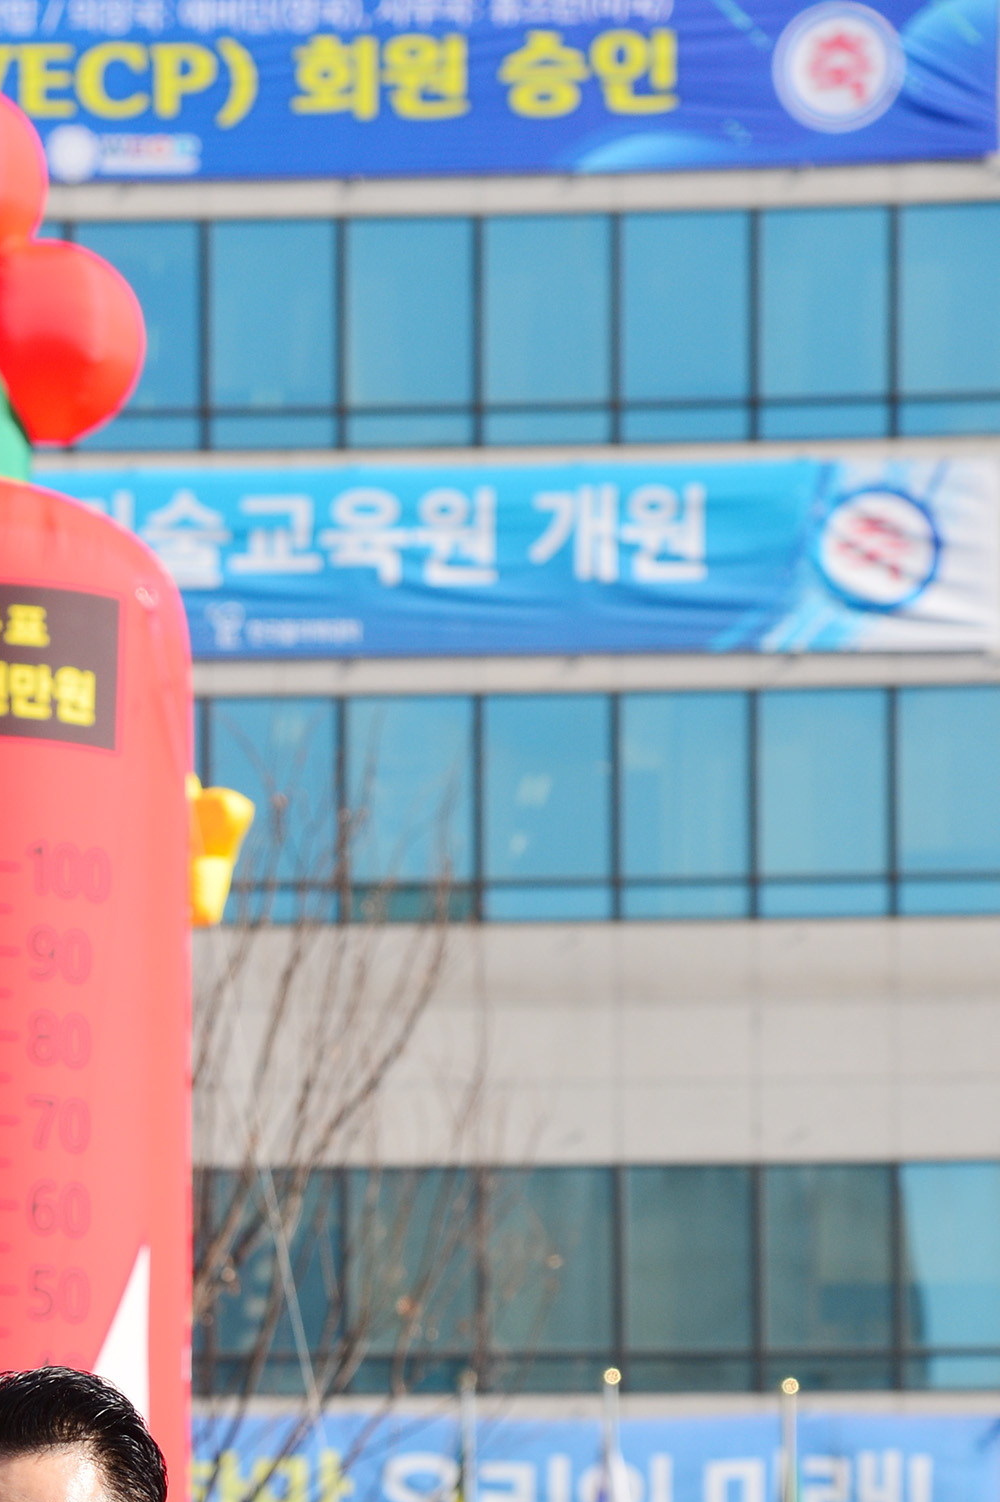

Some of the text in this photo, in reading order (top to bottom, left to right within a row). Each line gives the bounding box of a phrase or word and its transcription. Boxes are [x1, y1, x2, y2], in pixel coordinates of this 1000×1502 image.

[291, 34, 469, 119] 회원
[500, 28, 678, 118] 승인
[529, 483, 706, 582] 개원
[25, 839, 112, 904] 100
[27, 923, 93, 986] 90
[26, 1009, 92, 1071] 80
[26, 1093, 92, 1155] 70
[26, 1178, 92, 1240] 60
[26, 1264, 92, 1326] 50
